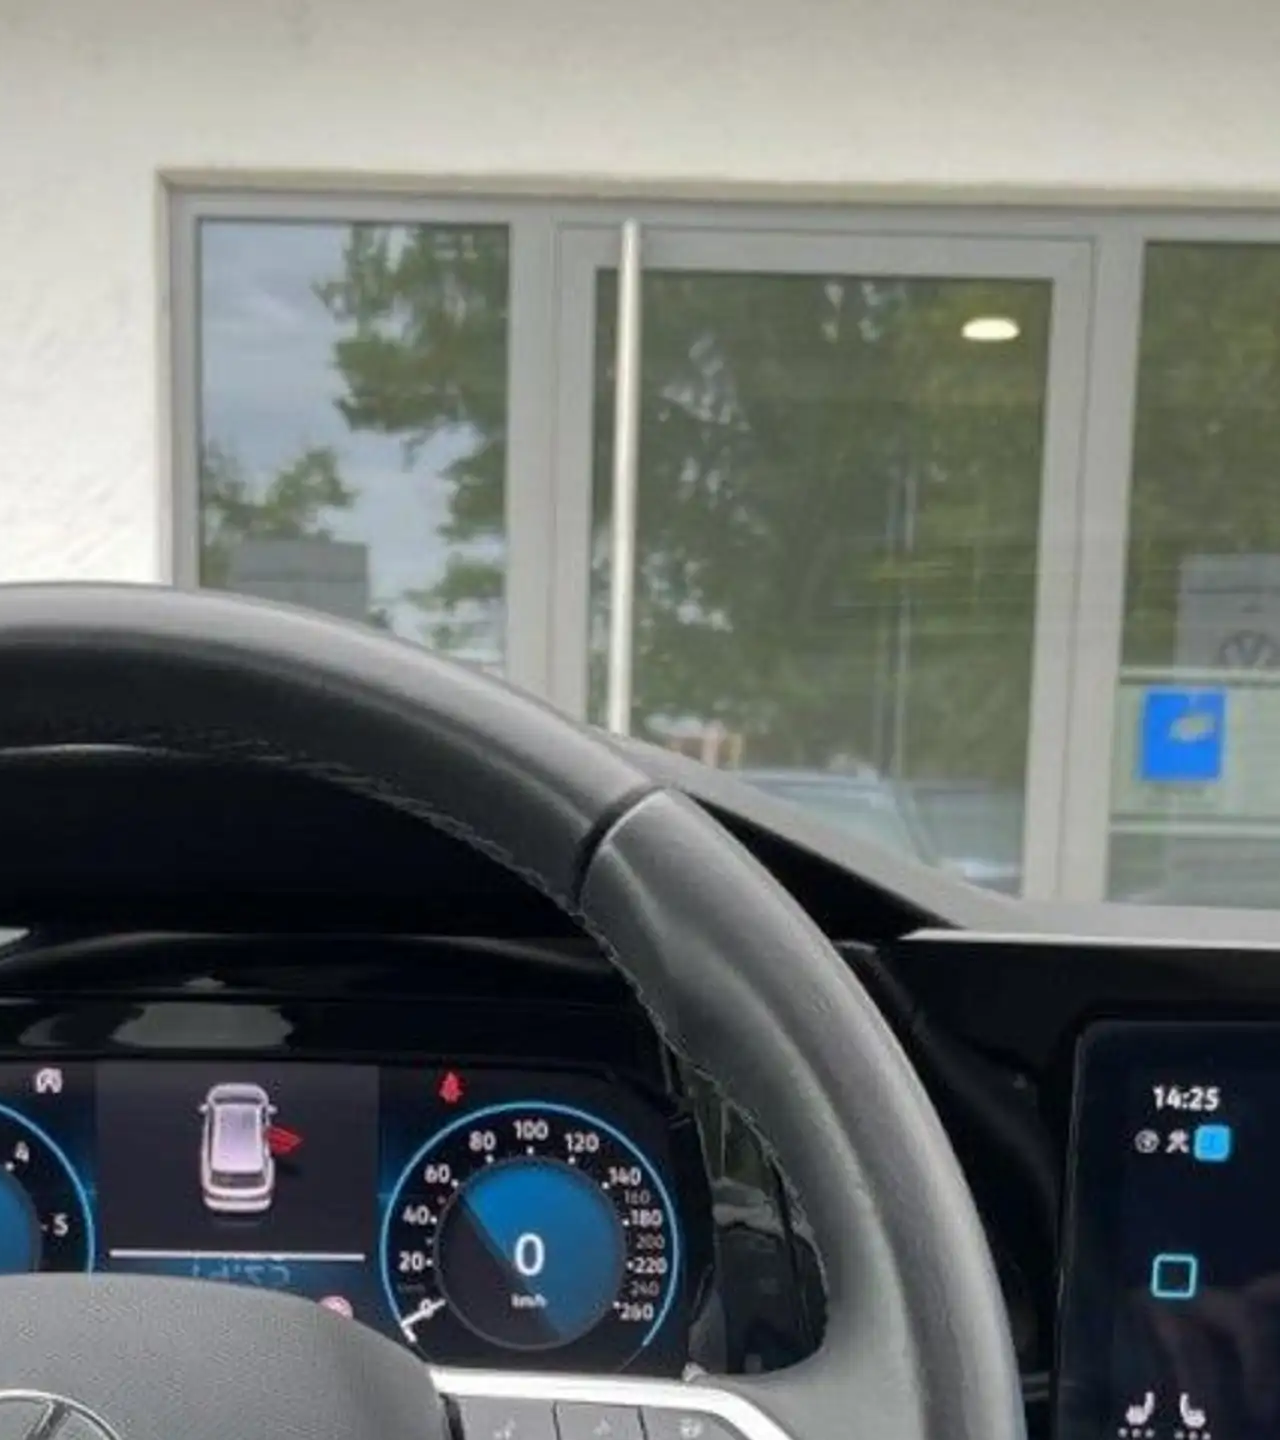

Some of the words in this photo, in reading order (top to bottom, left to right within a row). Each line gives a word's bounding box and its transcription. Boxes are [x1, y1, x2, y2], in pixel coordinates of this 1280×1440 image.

[1153, 1086, 1219, 1111] 14:25
[469, 1131, 496, 1151] 80
[513, 1120, 549, 1141] 100
[15, 1141, 30, 1163] 4
[565, 1132, 599, 1153] 120
[424, 1164, 450, 1184] 60
[607, 1166, 641, 1187] 140
[53, 1213, 69, 1236] 5
[403, 1205, 429, 1225] 40
[631, 1208, 663, 1228] 180
[399, 1251, 423, 1271] 20
[514, 1232, 545, 1276] 0
[635, 1255, 667, 1276] 220
[619, 1302, 654, 1322] 260
